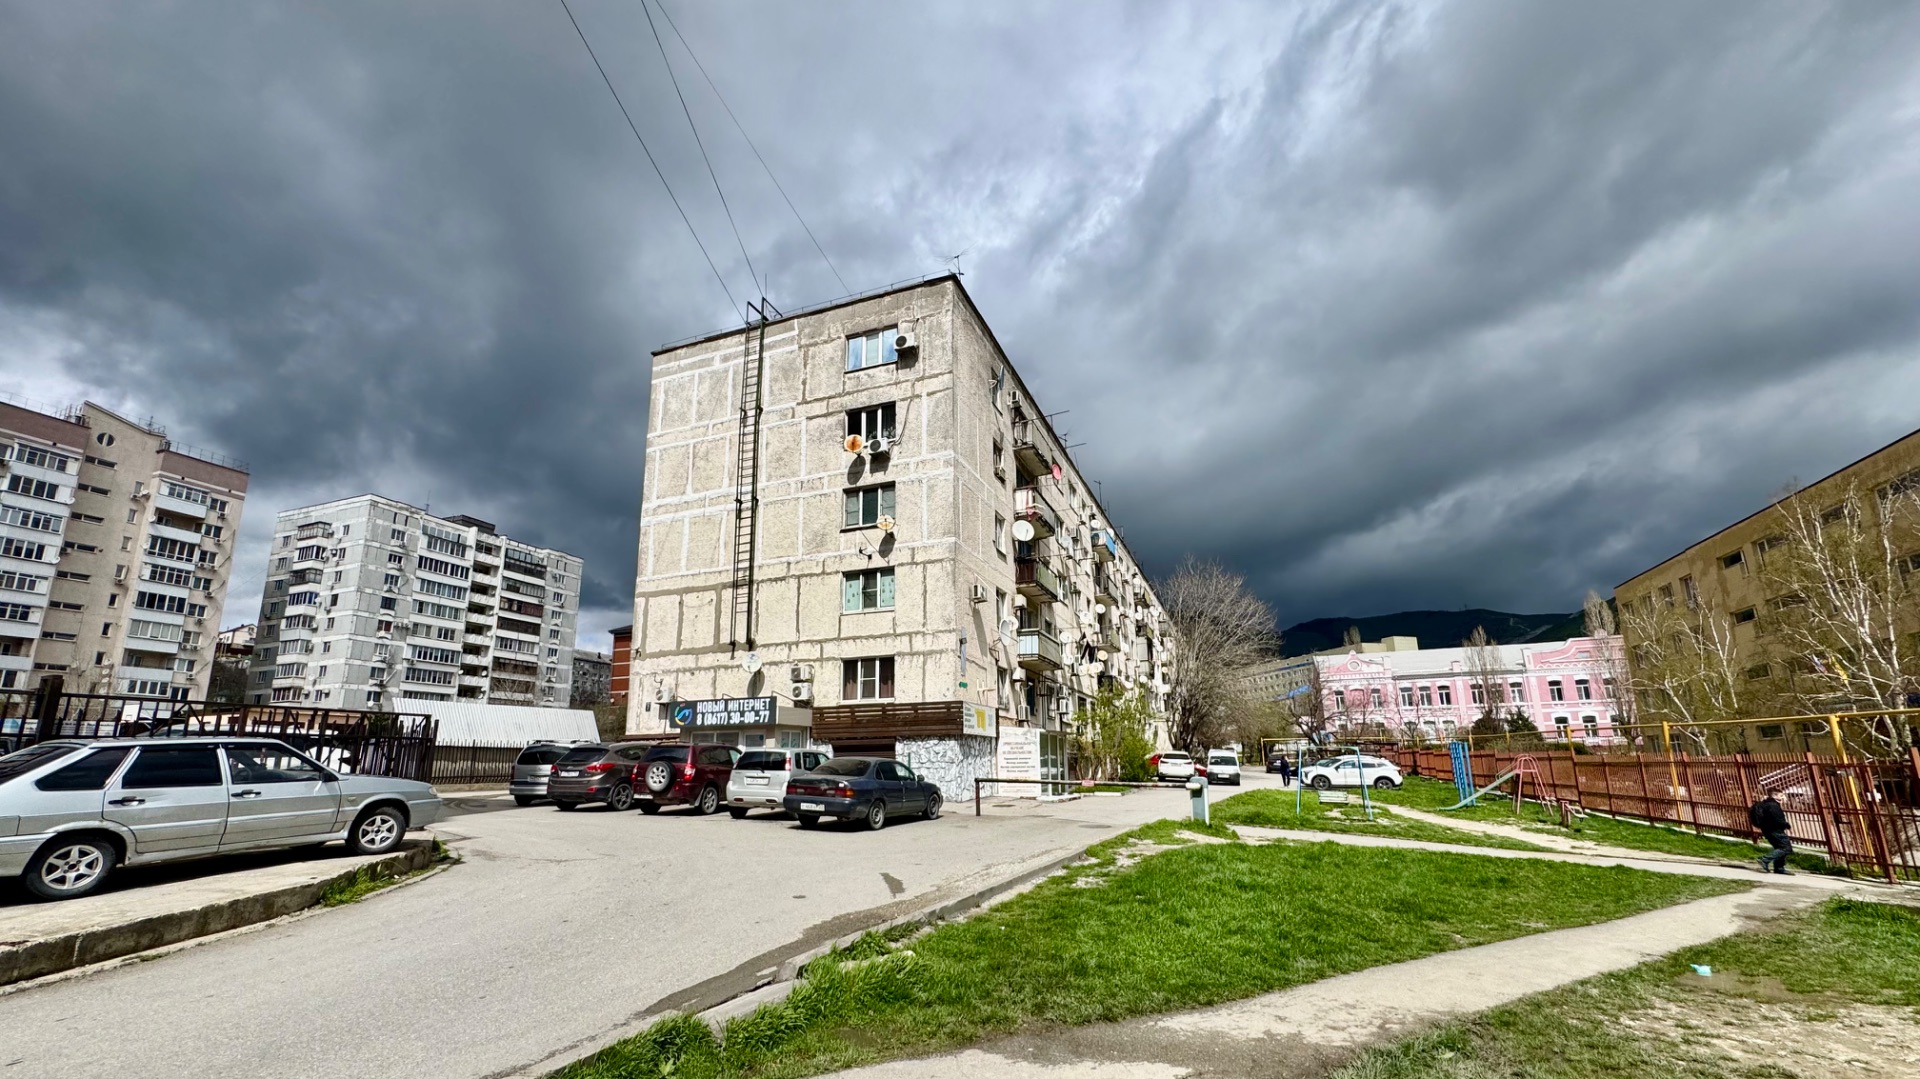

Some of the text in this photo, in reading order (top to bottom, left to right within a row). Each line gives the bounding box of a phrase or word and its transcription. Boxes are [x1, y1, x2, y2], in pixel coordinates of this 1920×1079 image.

[697, 698, 770, 713] НОВЫЙ ИНТЕРНЕТ
[697, 711, 770, 725] 8 (8617) 30-00-77
